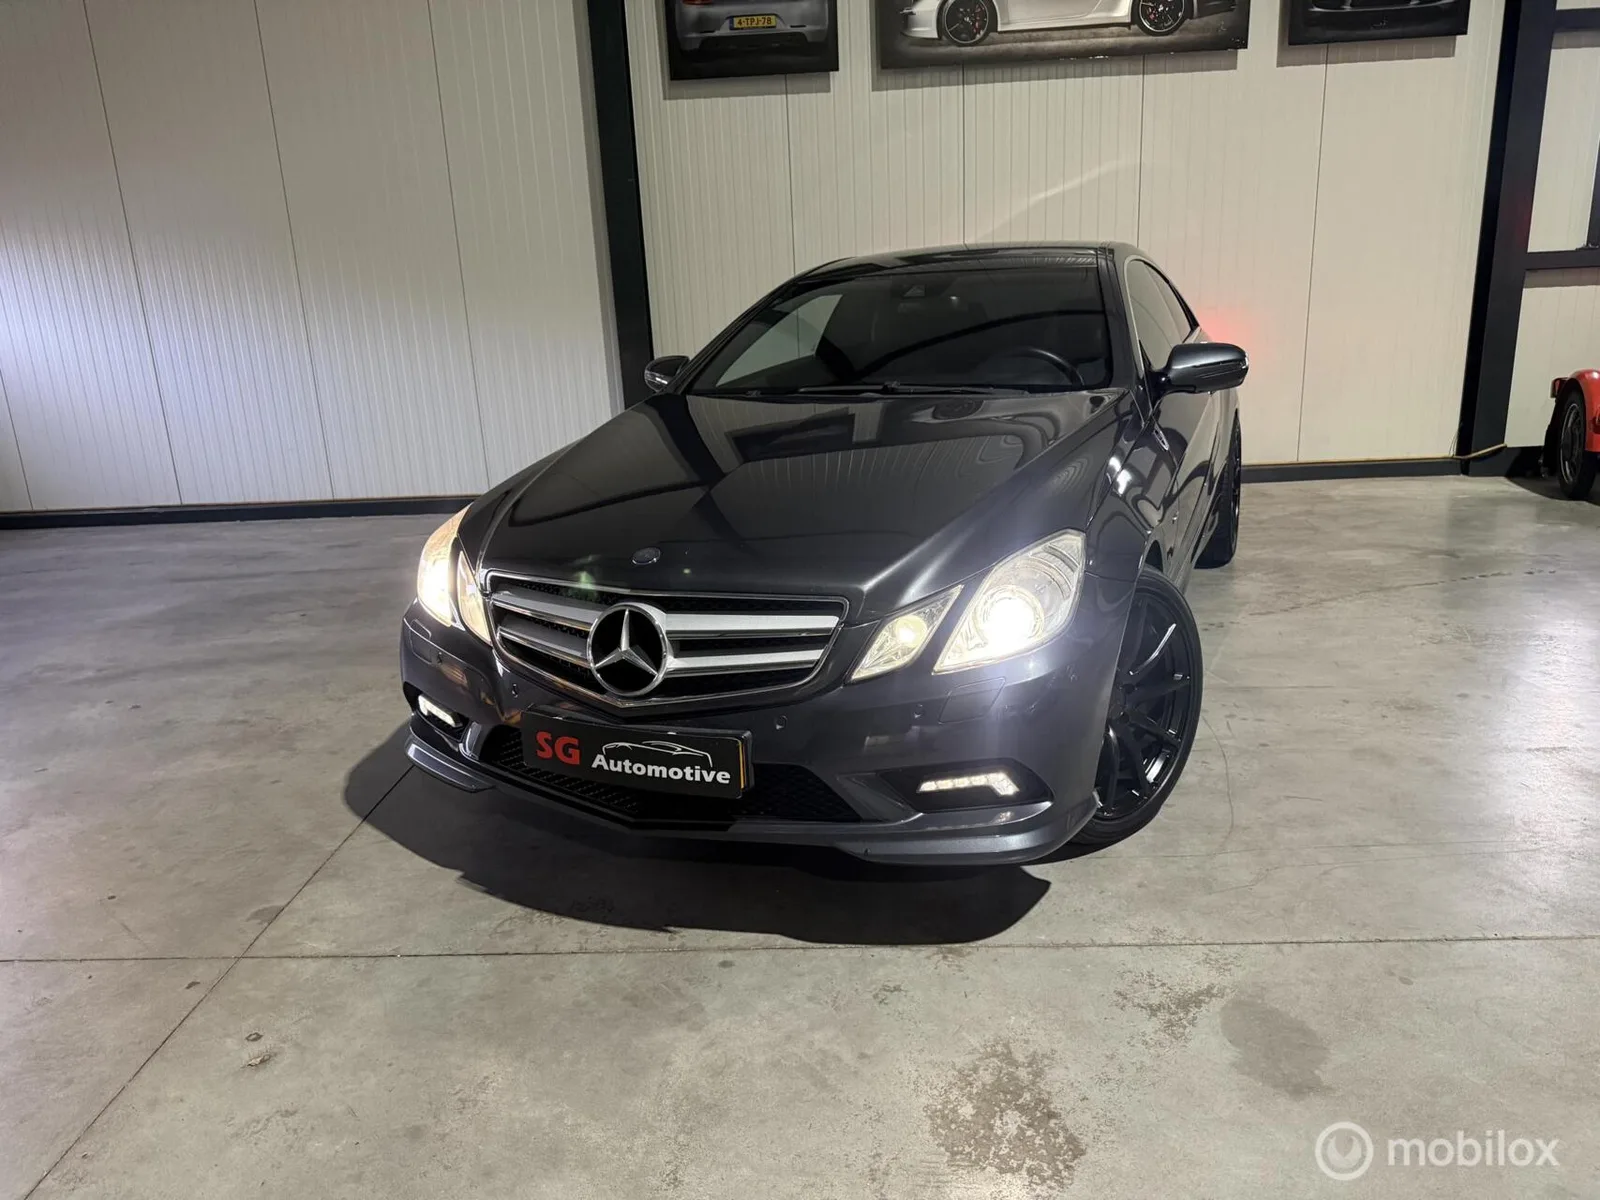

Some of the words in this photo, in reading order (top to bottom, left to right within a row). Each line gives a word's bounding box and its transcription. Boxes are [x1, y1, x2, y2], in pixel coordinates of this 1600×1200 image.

[736, 16, 773, 26] 4-TPJ-78
[535, 731, 581, 765] SG
[591, 753, 731, 784] Automotive
